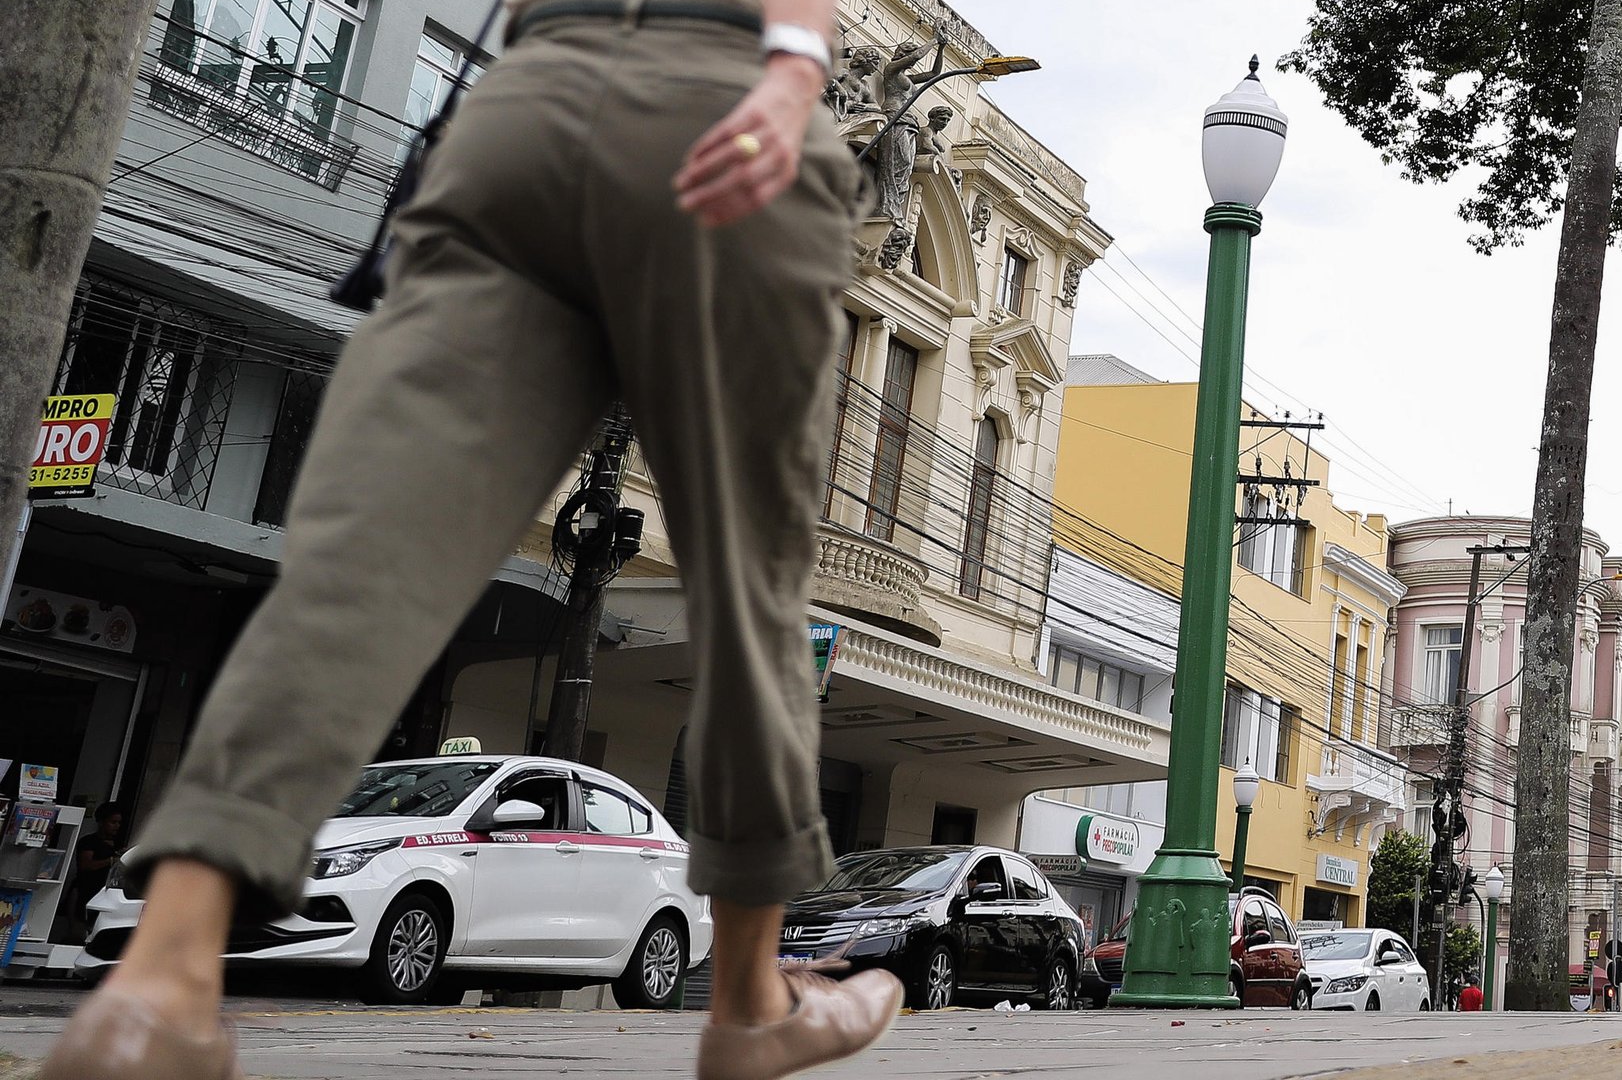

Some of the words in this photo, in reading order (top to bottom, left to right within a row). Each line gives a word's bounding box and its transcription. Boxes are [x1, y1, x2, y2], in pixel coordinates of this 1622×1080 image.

[444, 740, 472, 753] TÁXI
[432, 832, 470, 844] ESTRELA
[1103, 826, 1135, 842] FARMÁCIA
[1325, 866, 1354, 884] CENTRAL
